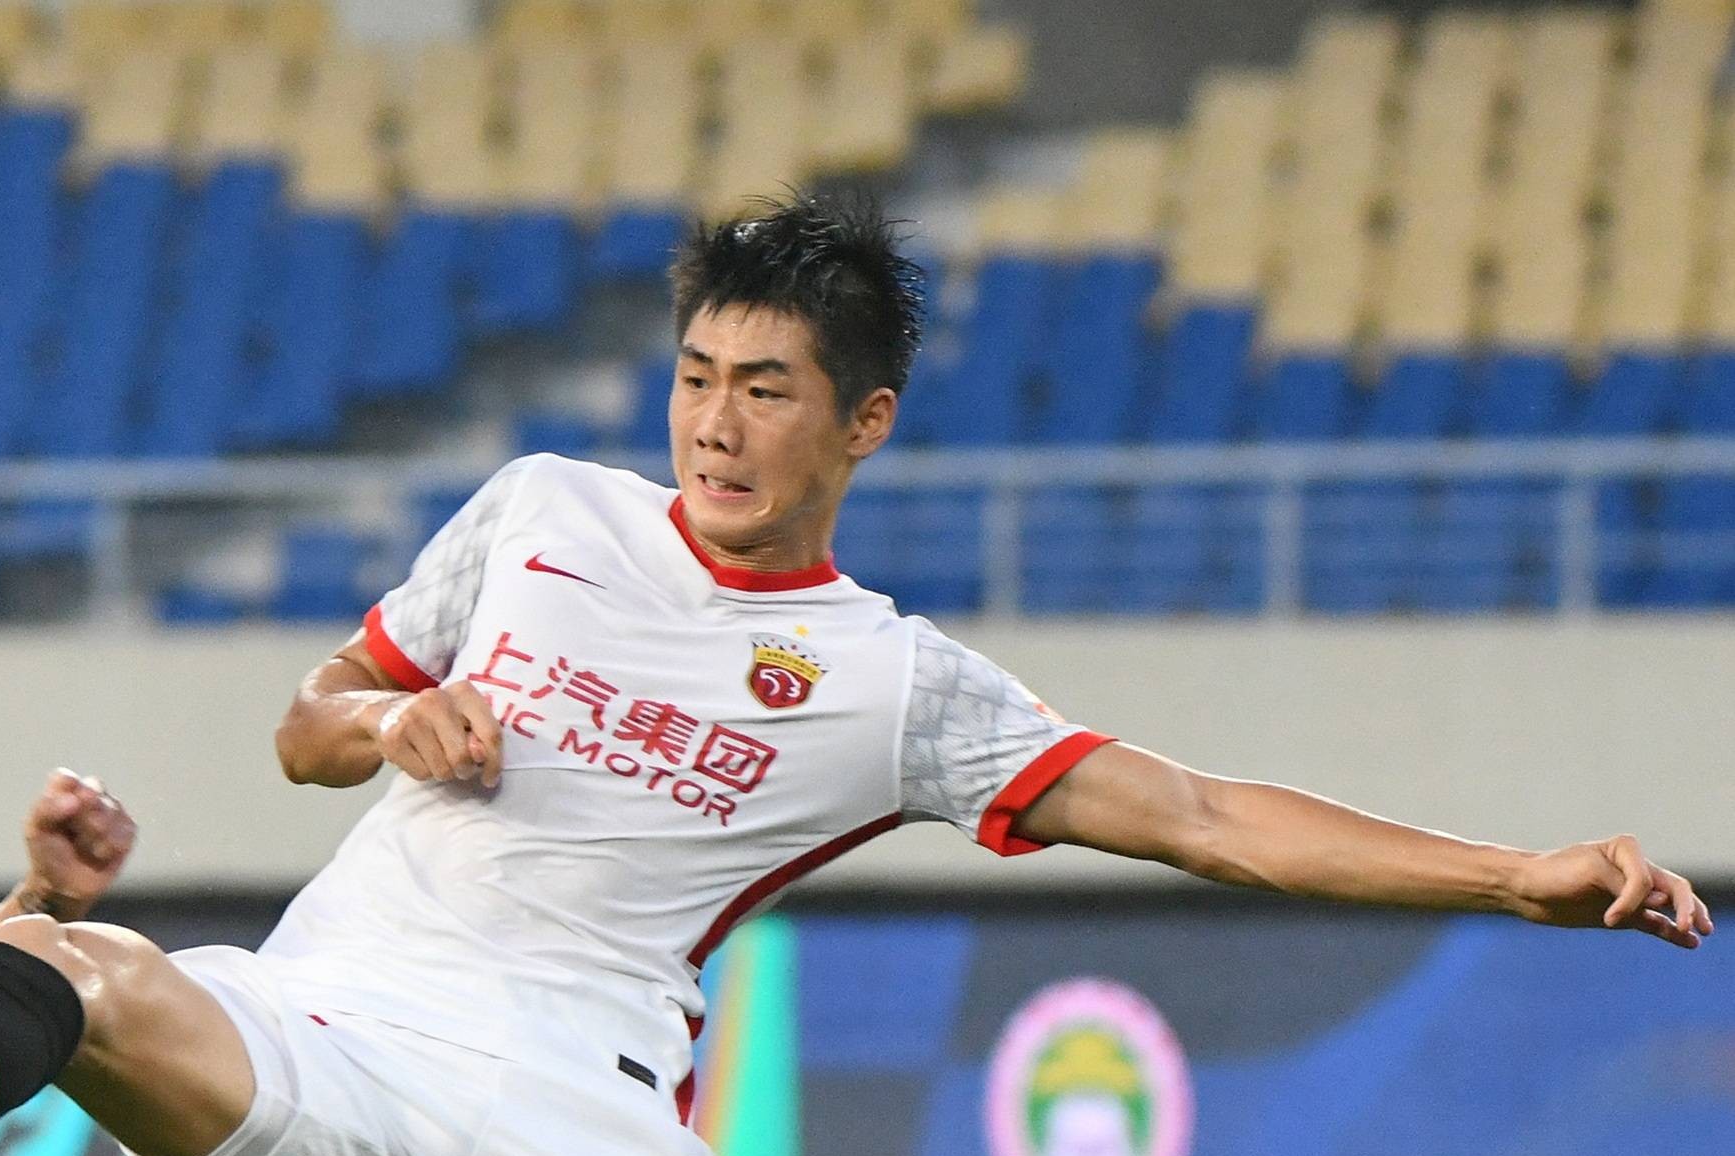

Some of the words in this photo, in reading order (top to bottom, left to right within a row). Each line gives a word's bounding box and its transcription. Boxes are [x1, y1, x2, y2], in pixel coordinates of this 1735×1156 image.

[467, 630, 779, 795] 上汽集团
[558, 727, 739, 828] MOTOR
